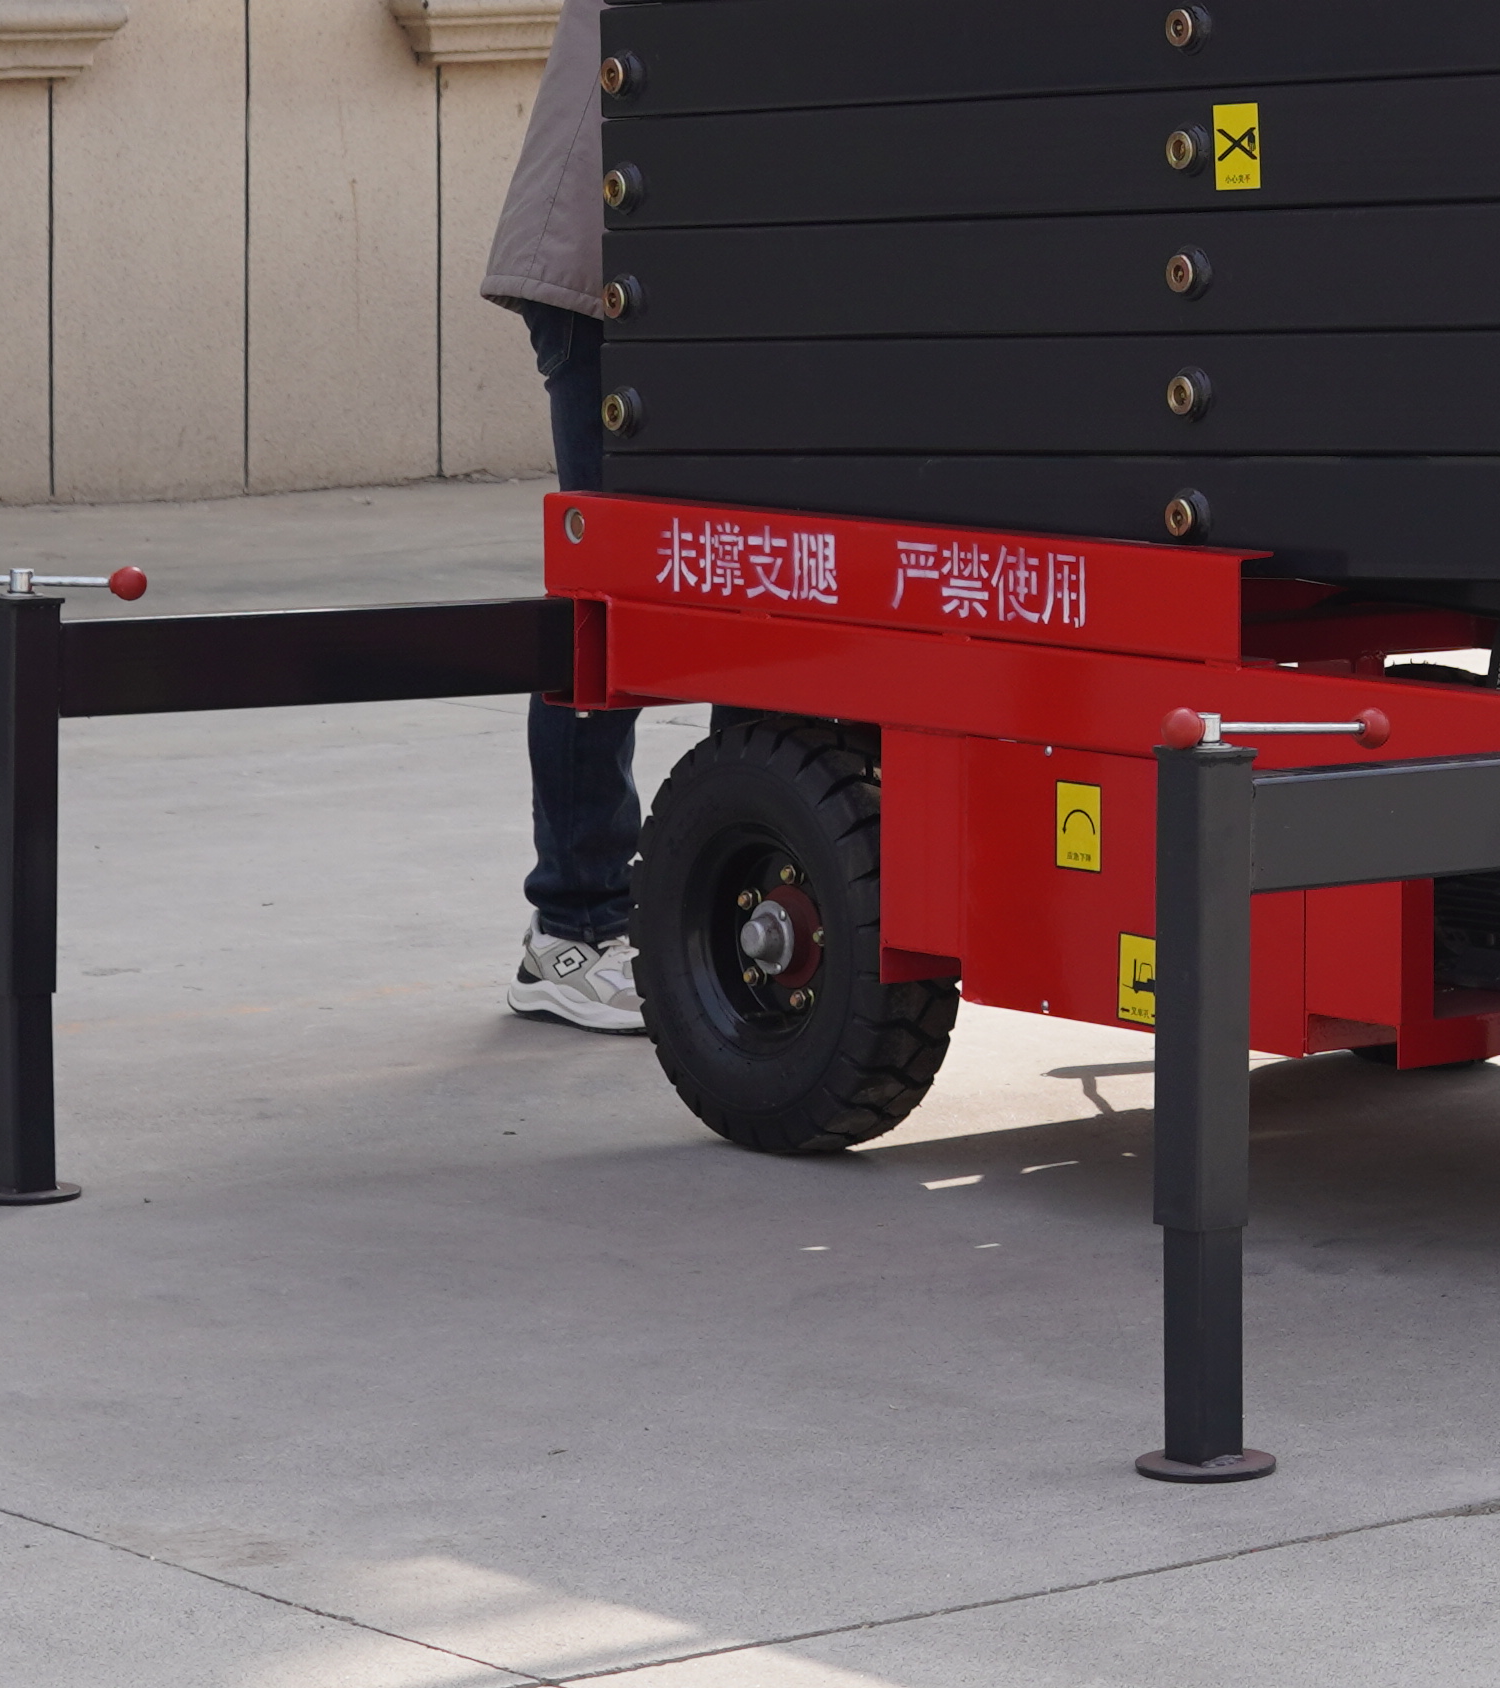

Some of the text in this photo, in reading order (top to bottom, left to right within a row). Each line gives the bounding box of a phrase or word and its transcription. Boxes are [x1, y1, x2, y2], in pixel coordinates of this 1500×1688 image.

[655, 516, 1088, 629] 未撑支腿 严禁使用
